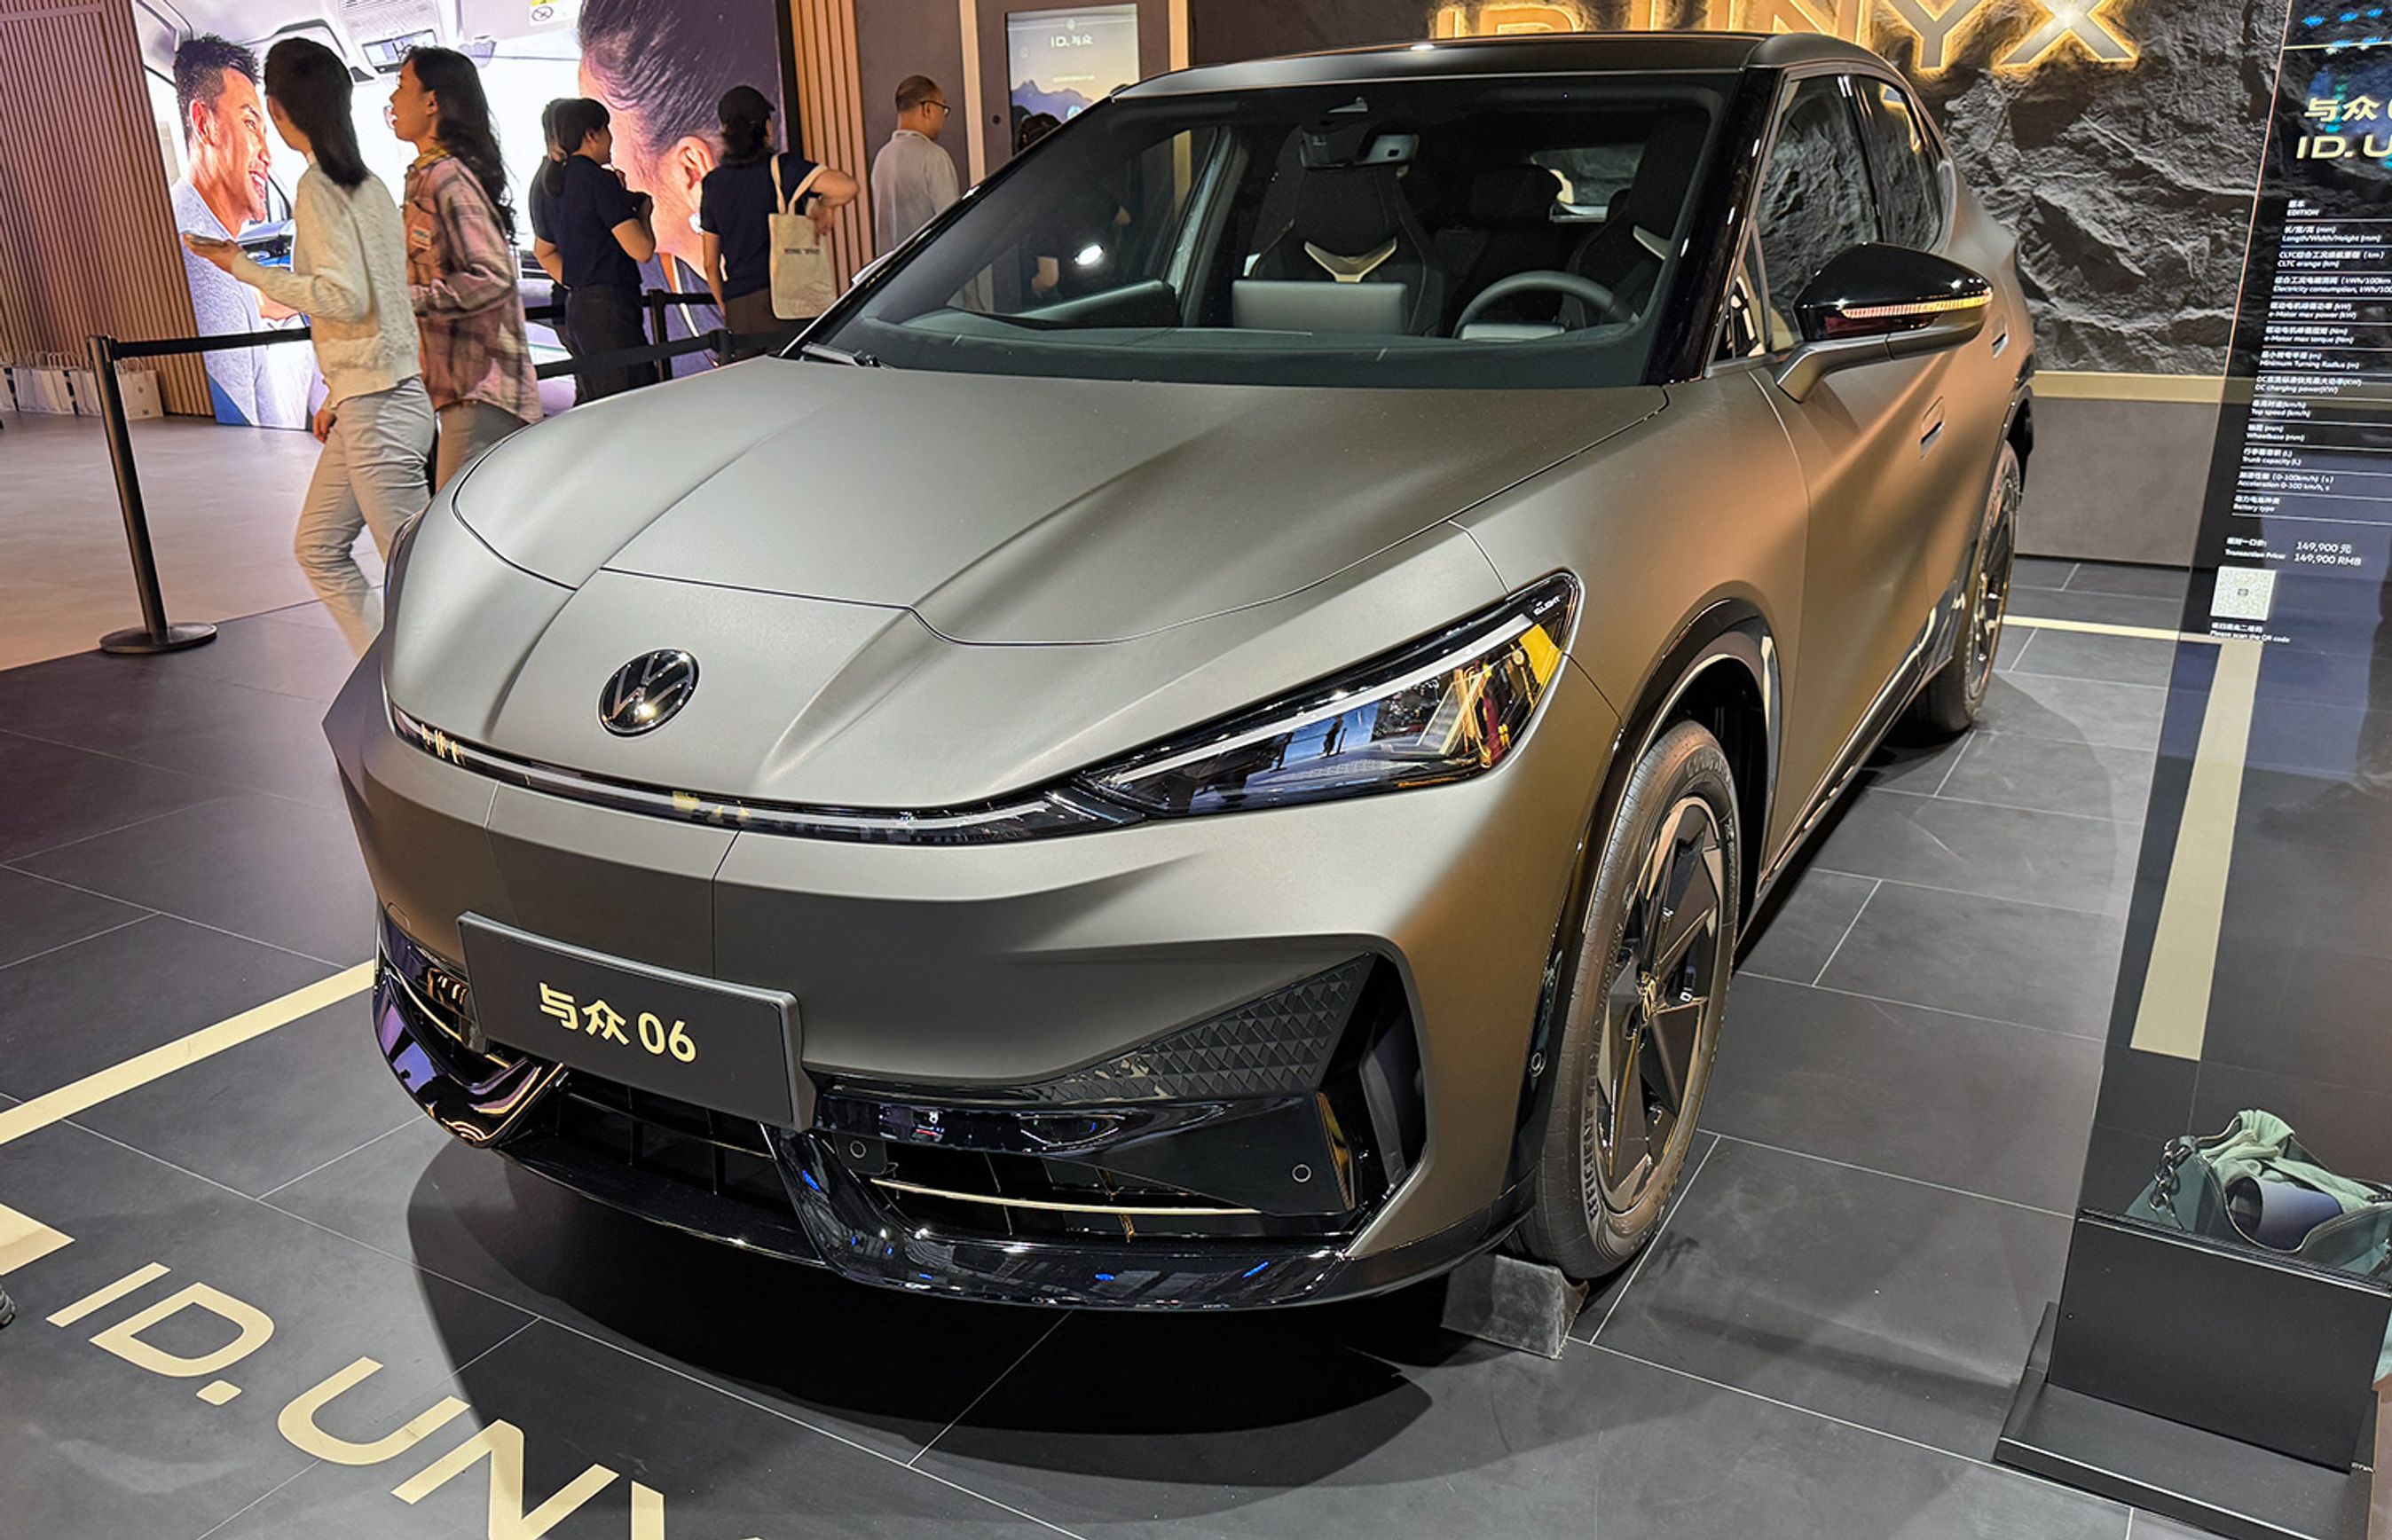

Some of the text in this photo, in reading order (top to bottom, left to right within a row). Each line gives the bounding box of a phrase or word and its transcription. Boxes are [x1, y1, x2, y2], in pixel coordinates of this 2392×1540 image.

[2304, 96, 2380, 122] 与众
[2296, 541, 2338, 554] 149,900
[2294, 553, 2335, 565] 149,900
[2337, 557, 2362, 566] RMB
[539, 982, 696, 1064] 与众 06
